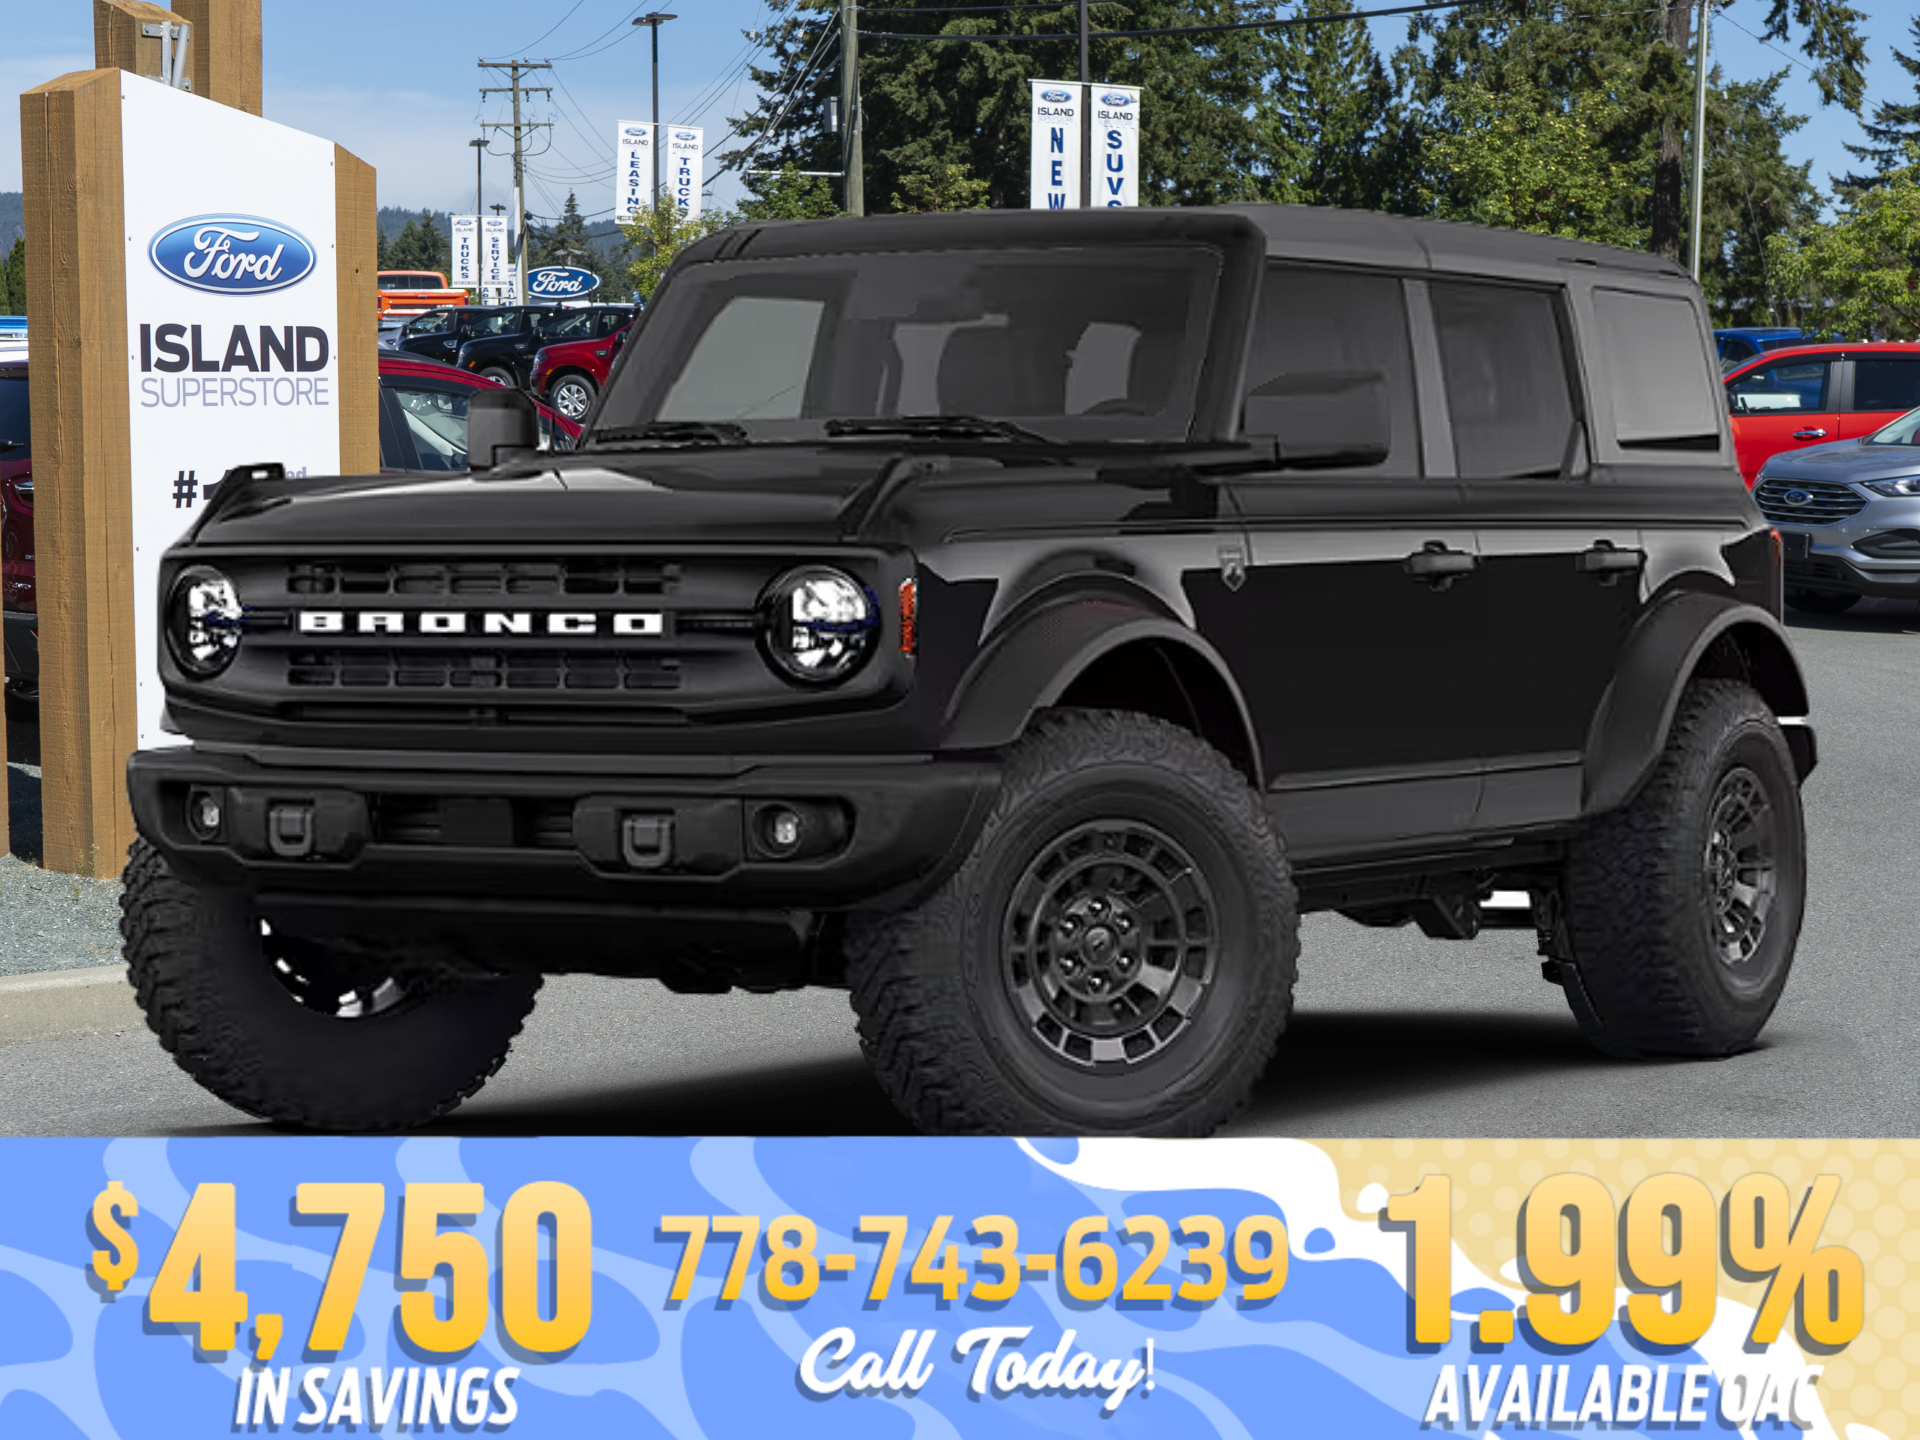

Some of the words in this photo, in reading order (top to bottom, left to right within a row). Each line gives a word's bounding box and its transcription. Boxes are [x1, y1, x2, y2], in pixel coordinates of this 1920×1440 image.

[1037, 107, 1074, 117] ISLAND
[1098, 110, 1133, 121] ISLAND
[1048, 127, 1066, 209] NEW
[184, 226, 285, 281] Ford
[461, 237, 470, 279] TRUCKS
[491, 237, 500, 280] SERVICE
[532, 271, 583, 292] Ford
[139, 323, 329, 373] ISLAND
[140, 377, 329, 408] SUPERSTORE
[300, 611, 663, 634] BRONCO
